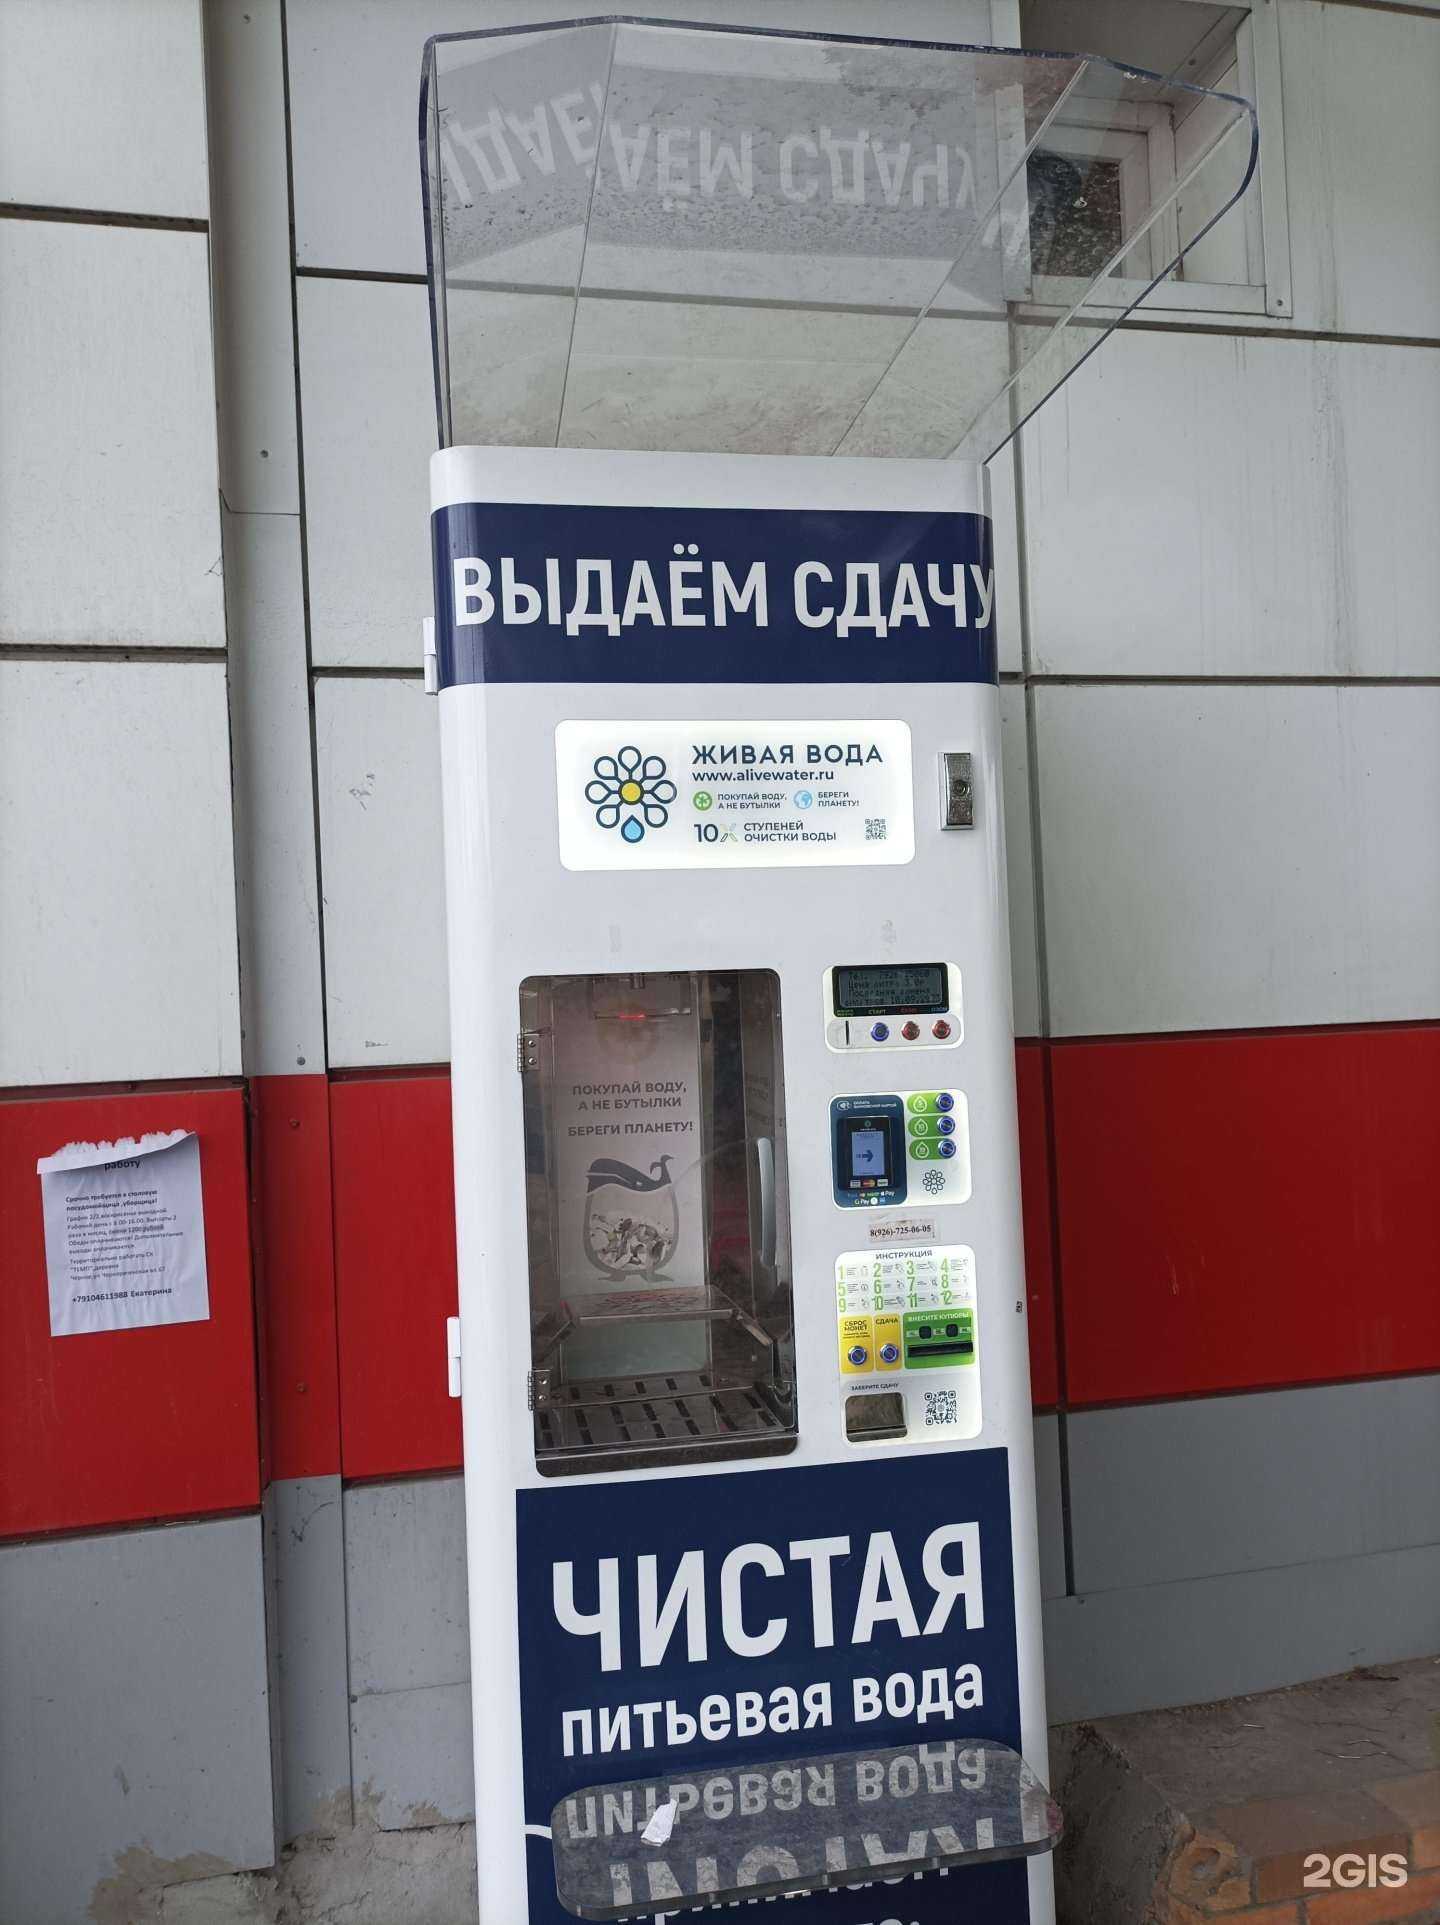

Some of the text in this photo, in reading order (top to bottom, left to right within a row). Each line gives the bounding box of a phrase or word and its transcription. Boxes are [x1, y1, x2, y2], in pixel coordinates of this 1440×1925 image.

[452, 543, 995, 638] ВЫДАЁМ СДАЧУ
[692, 744, 884, 766] ЖИВАЯ ВОДА
[692, 768, 834, 781] www.alivewater.ru
[717, 791, 788, 801] ПОКУПАЙ ВОДУ,
[818, 791, 849, 799] БЕРЕГИ
[739, 801, 781, 809] БУТЫЛКИ
[818, 800, 860, 808] ПЛАНЕТУ!
[744, 820, 804, 831] СТУПЕНЕЙ
[744, 832, 837, 842] ОЧИСТКИ ВОДЫ
[572, 1080, 687, 1096] ПОКУПАЙ ВОДУ,
[578, 1096, 682, 1111] А НЕ БУТЫЛКИ
[568, 1120, 694, 1137] БЕРЕГИ ПЛАНЕТУ!
[875, 1250, 933, 1260] ИНСТРУКЦИЯ
[873, 1263, 881, 1277] 2
[906, 1260, 914, 1275] 3
[940, 1258, 949, 1273] 4
[873, 1280, 882, 1294] 6
[907, 1277, 916, 1291] 7
[941, 1274, 949, 1288] 8
[838, 1282, 846, 1296] 5
[872, 1296, 884, 1310] 10
[906, 1293, 918, 1307] 11
[940, 1290, 952, 1305] 12
[838, 1298, 846, 1312] 9
[552, 1521, 985, 1673] ЧИСТАЯ
[562, 1663, 984, 1757] питьевая вода
